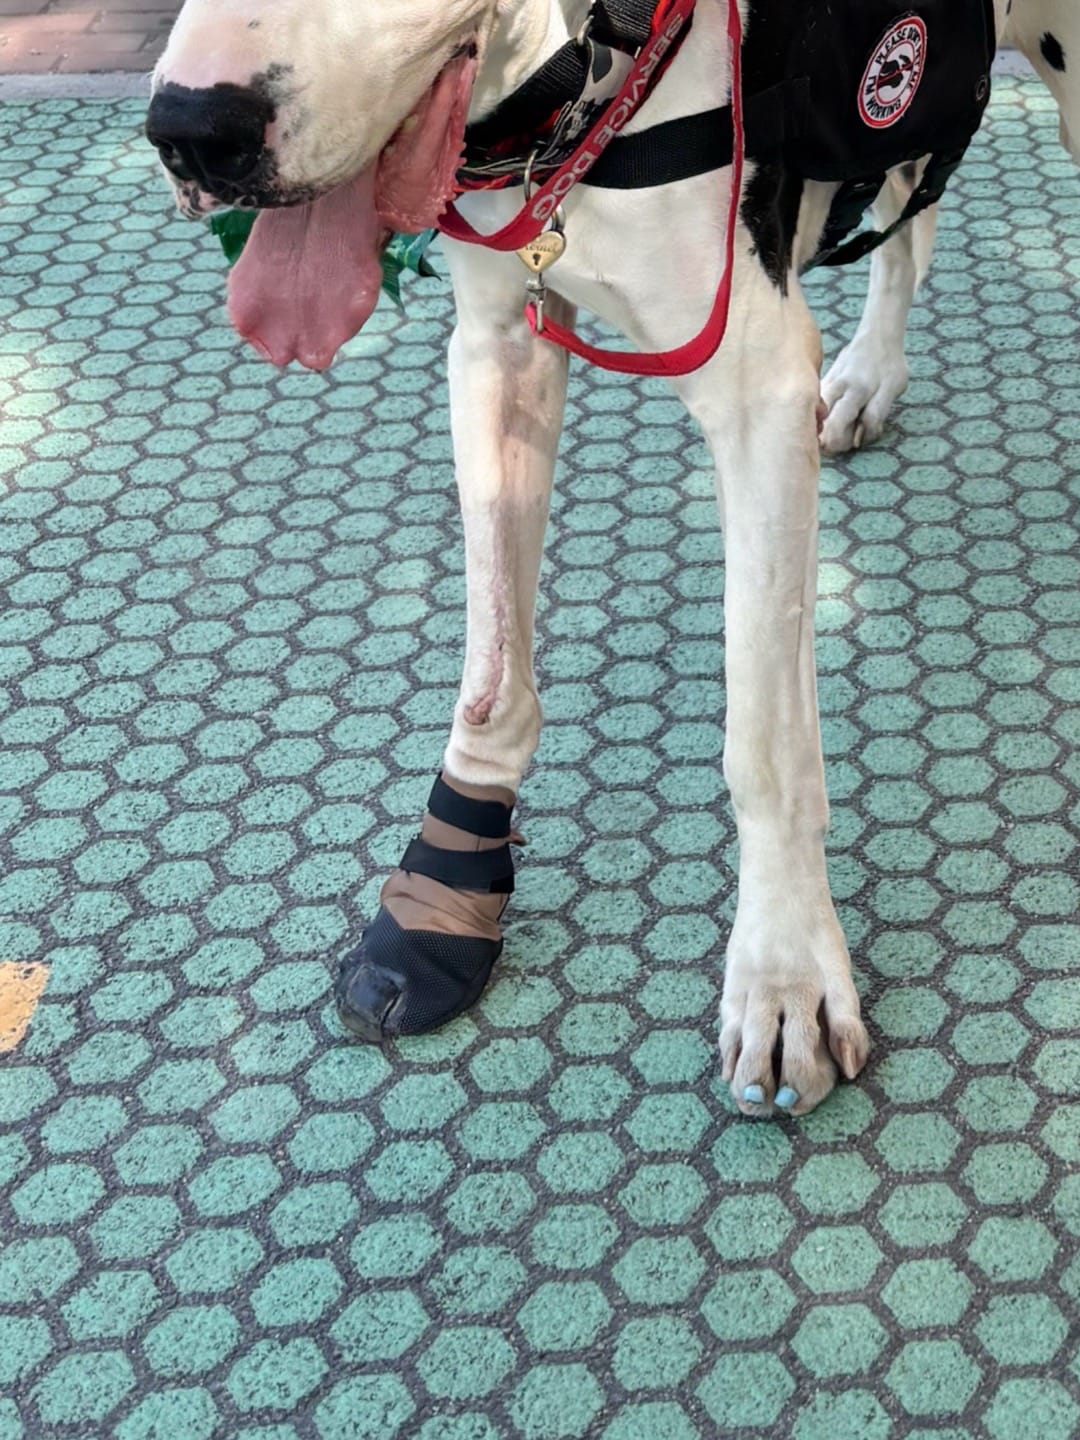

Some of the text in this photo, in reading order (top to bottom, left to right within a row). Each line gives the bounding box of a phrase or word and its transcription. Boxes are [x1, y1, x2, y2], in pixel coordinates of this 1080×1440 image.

[874, 26, 906, 65] PLEASE
[594, 12, 684, 147] SERVICE
[865, 97, 901, 119] WORKING
[531, 150, 596, 221] DOG
